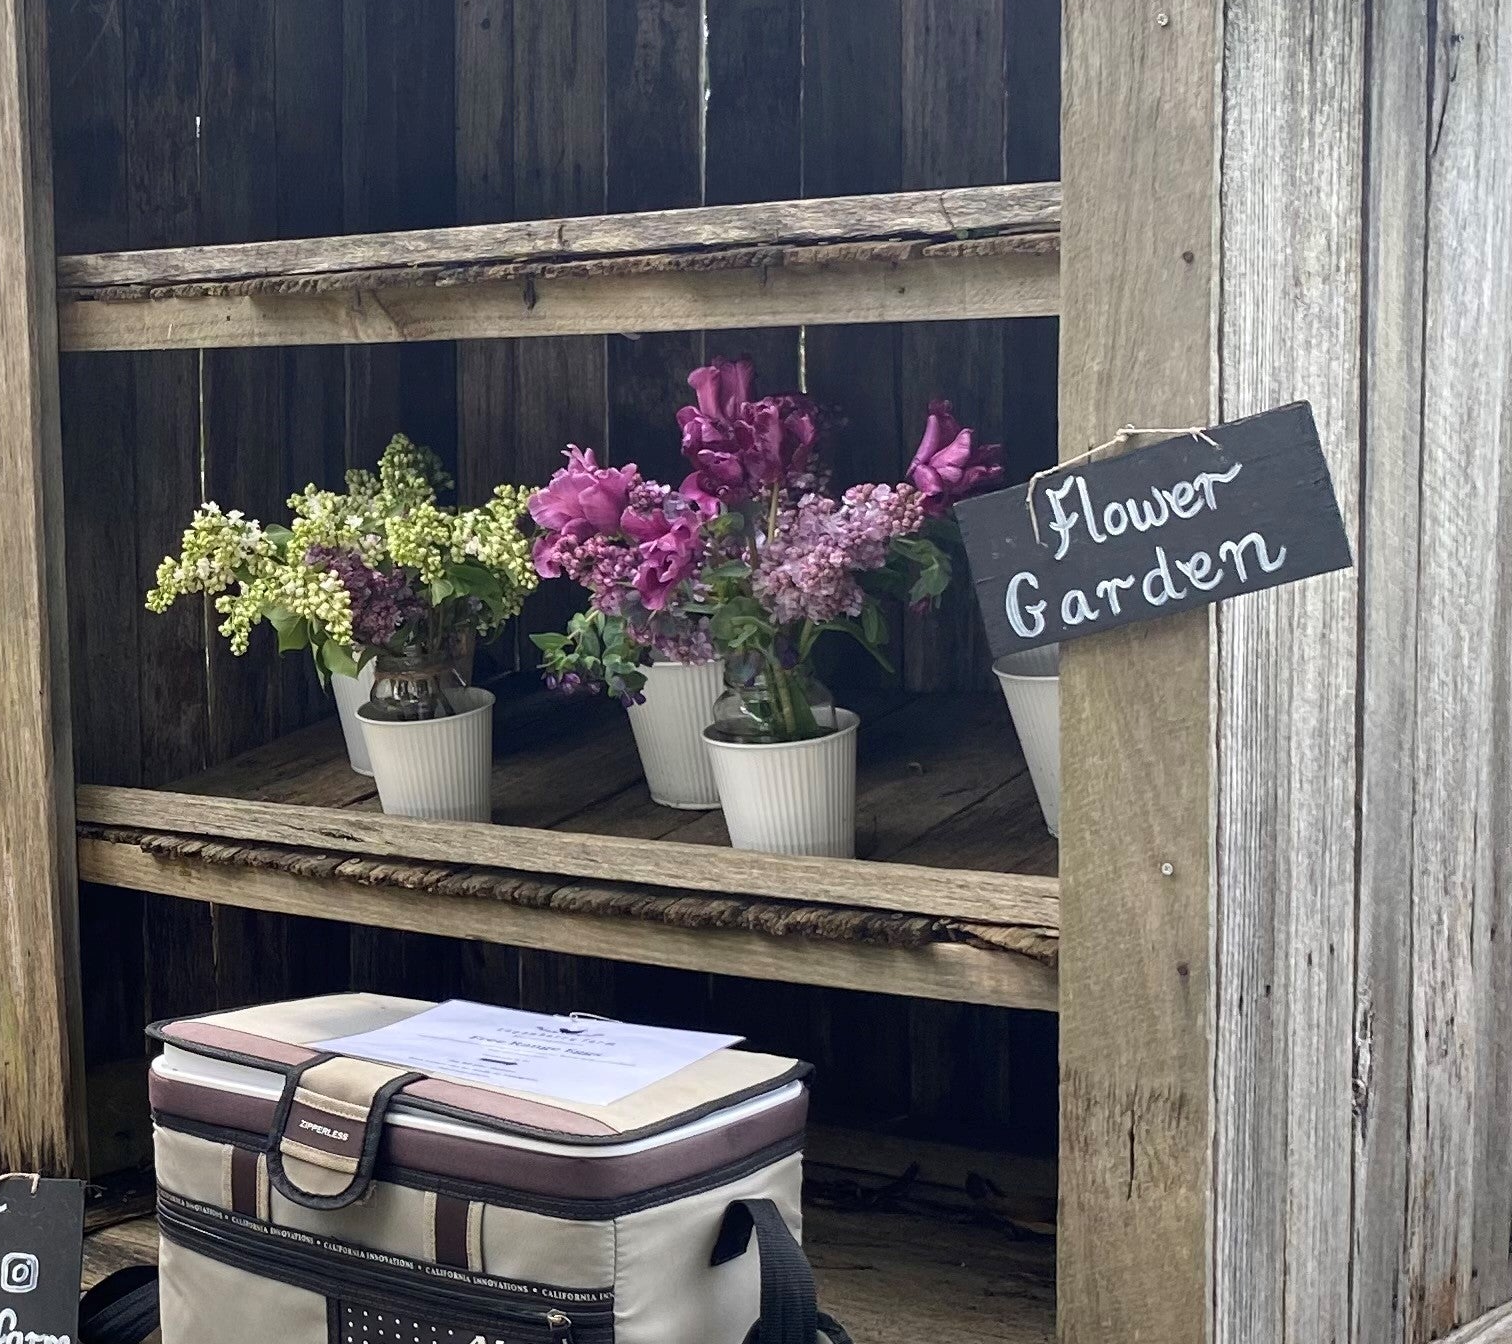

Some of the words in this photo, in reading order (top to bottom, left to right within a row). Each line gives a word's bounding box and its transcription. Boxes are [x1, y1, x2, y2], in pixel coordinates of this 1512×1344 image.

[1045, 462, 1242, 560] Flower
[1005, 531, 1287, 639] Garden
[299, 1119, 349, 1141] ZIPPERLESS
[231, 1215, 268, 1234] CALIFORNIA
[270, 1227, 314, 1245] INNOVATIONS
[323, 1241, 365, 1259] CALIFORNIA
[366, 1251, 414, 1270] INNOVATIONS
[425, 1266, 471, 1284] CALIFORNIA
[473, 1276, 529, 1293] INNOVATIONS
[541, 1288, 597, 1302] CALIFORNIA
